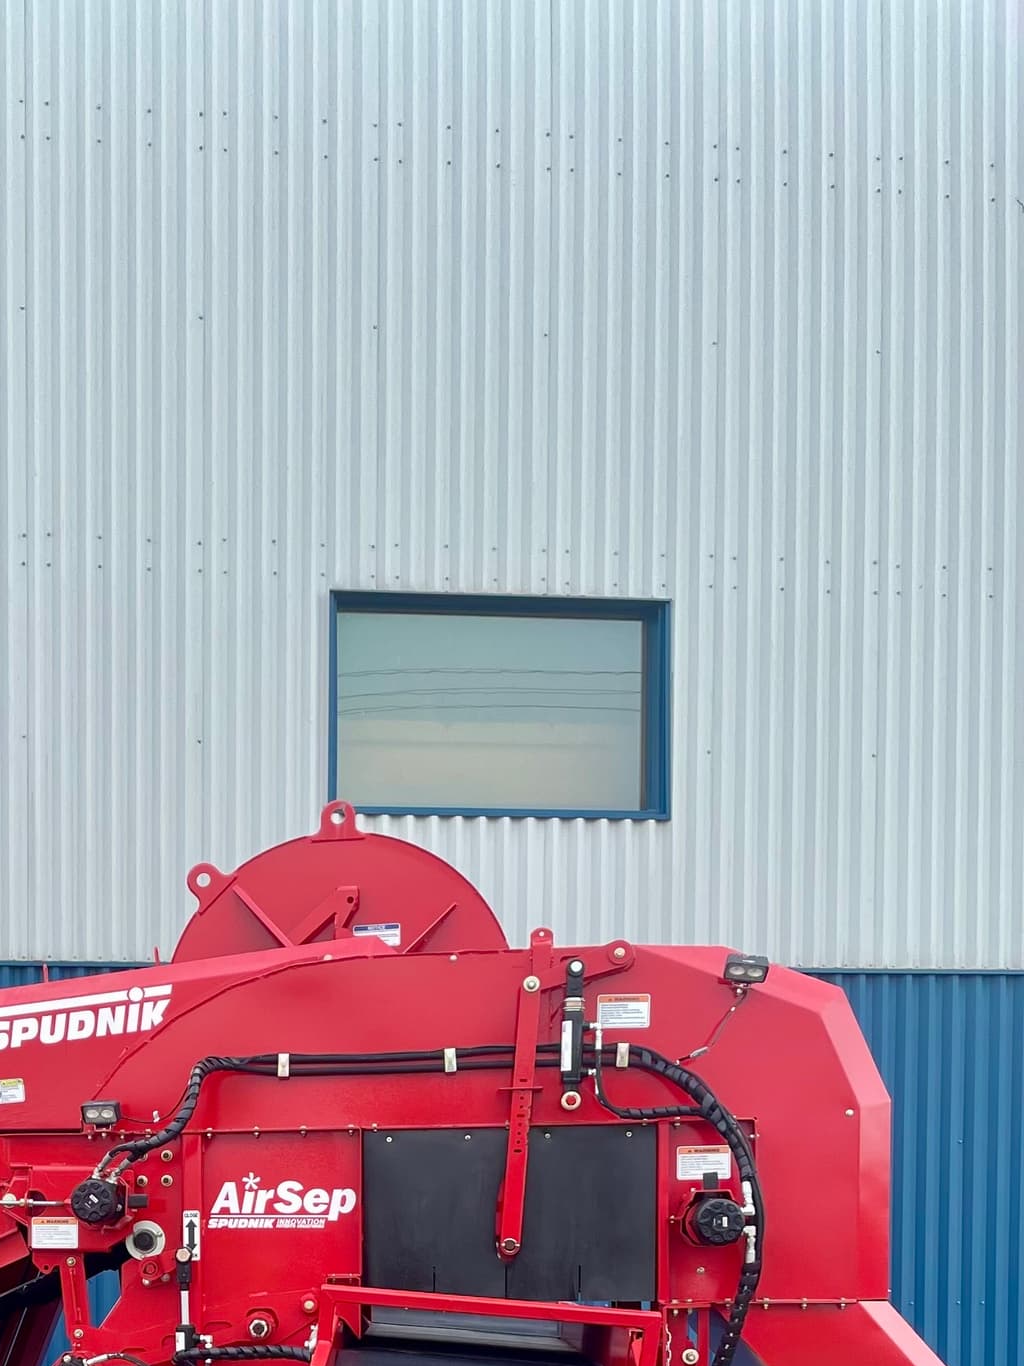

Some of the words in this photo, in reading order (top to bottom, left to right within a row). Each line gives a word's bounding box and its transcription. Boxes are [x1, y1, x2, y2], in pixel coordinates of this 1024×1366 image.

[210, 1172, 356, 1221] AirSep
[207, 1218, 275, 1228] SPUDNIK
[277, 1218, 325, 1226] INNOVATION
